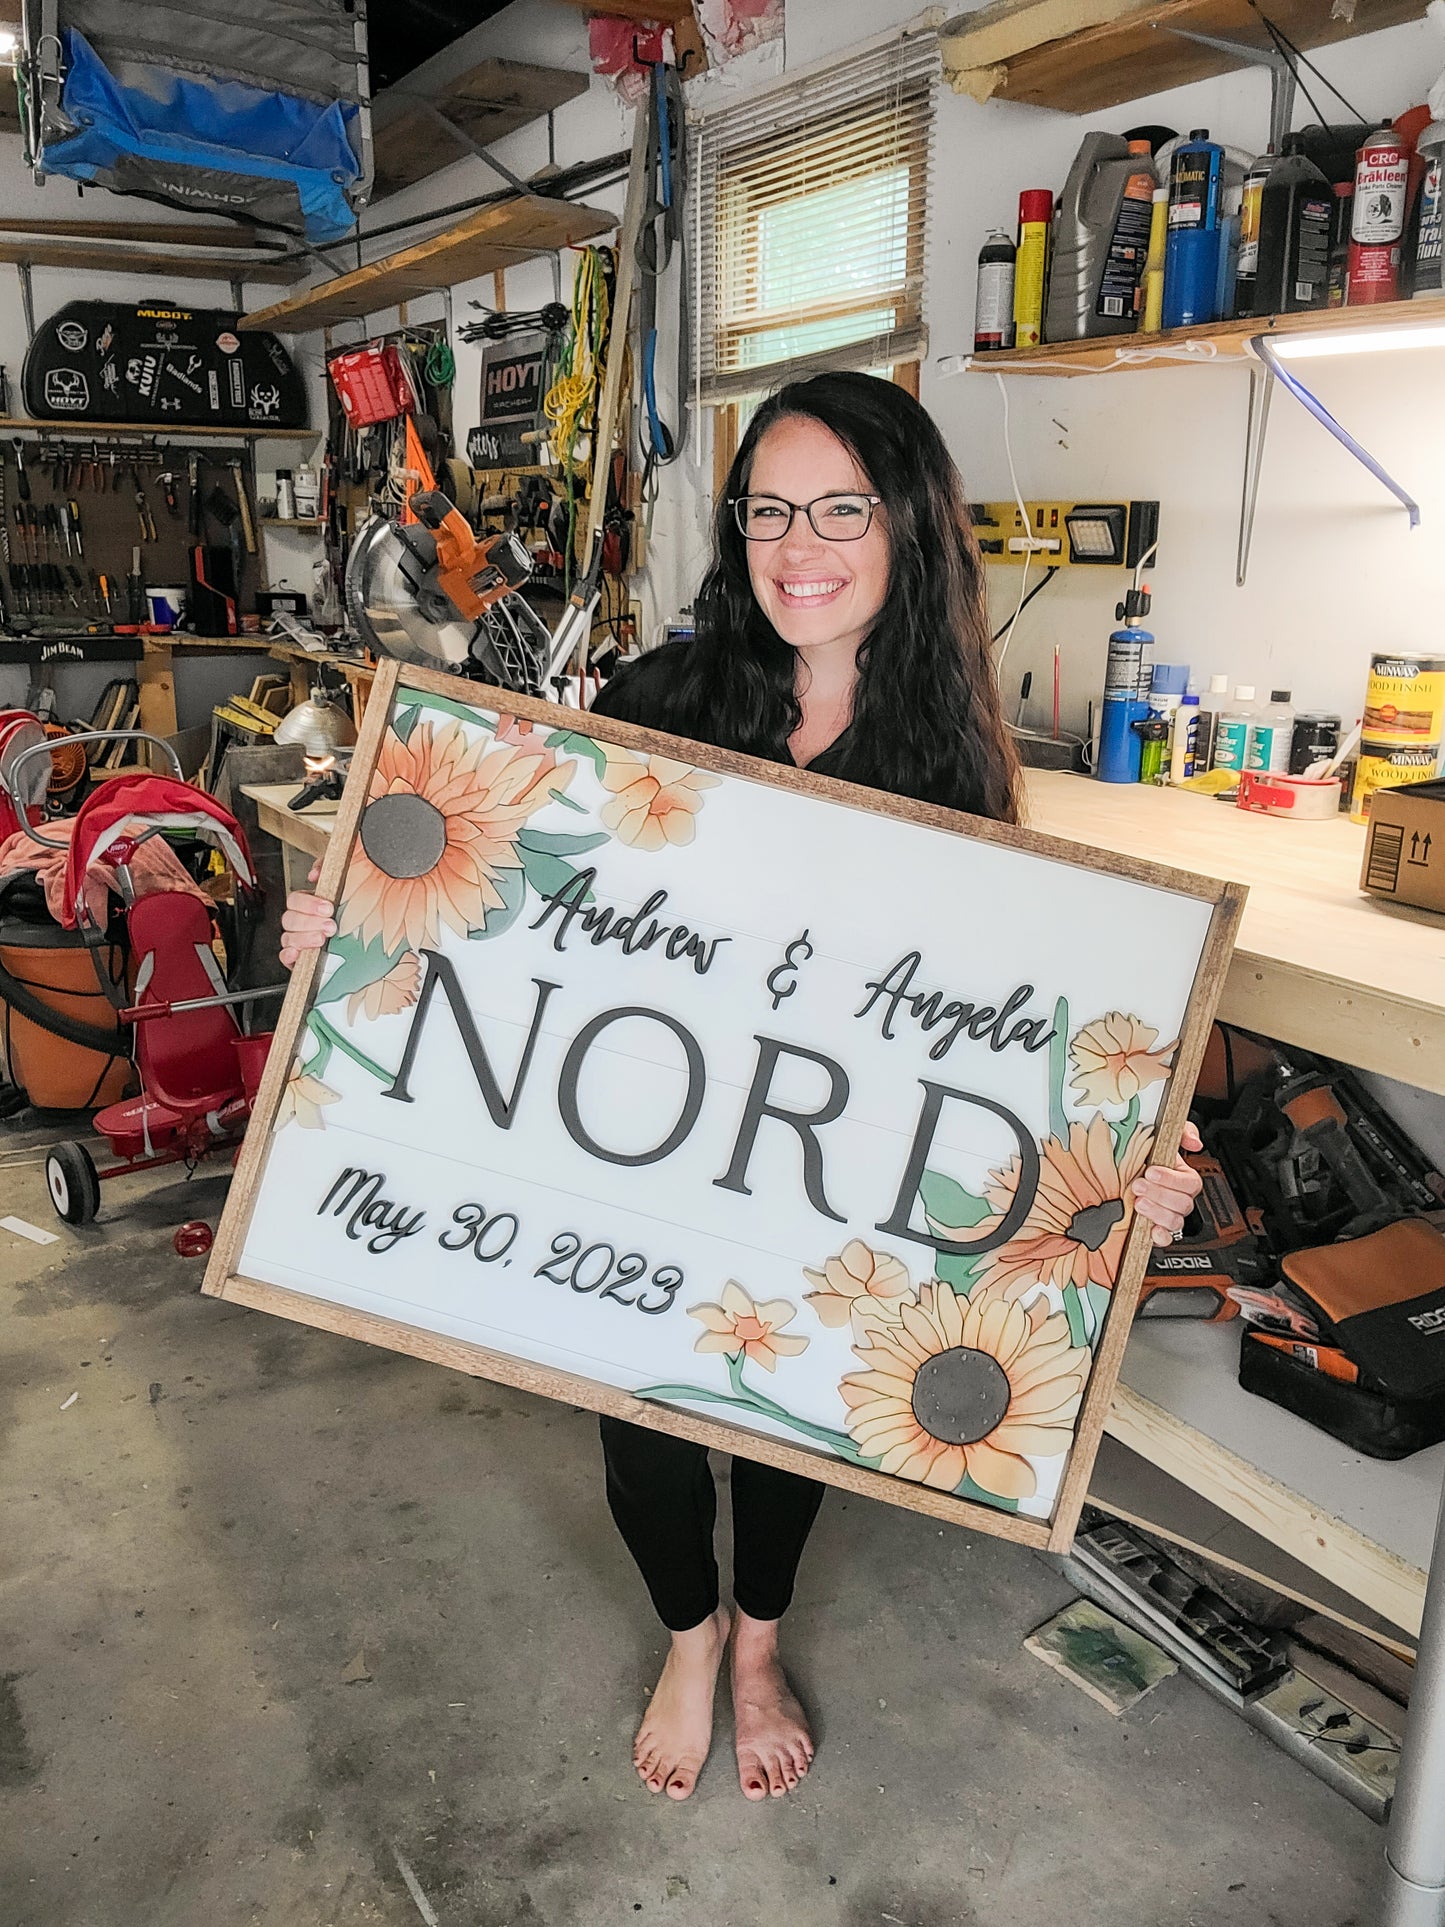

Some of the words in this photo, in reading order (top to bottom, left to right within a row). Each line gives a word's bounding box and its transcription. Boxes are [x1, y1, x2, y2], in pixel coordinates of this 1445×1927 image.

[1369, 152, 1398, 165] CRC
[1418, 227, 1441, 243] Bra
[137, 309, 191, 320] MUDDY
[138, 354, 157, 397] KUIU
[165, 362, 203, 395] Badlands
[488, 361, 543, 395] HOYT
[41, 645, 58, 660] JIM
[58, 641, 84, 659] BEAM
[1376, 665, 1416, 678] MINWAX
[1392, 682, 1432, 693] FINISH
[1371, 767, 1409, 780] WOOD
[529, 866, 733, 975] Andrew
[766, 928, 814, 1011] &
[853, 951, 1058, 1061] Angela
[381, 947, 1041, 1256] NORD
[317, 1166, 426, 1255] May
[438, 1203, 518, 1268] 30,
[533, 1232, 684, 1315] 2023
